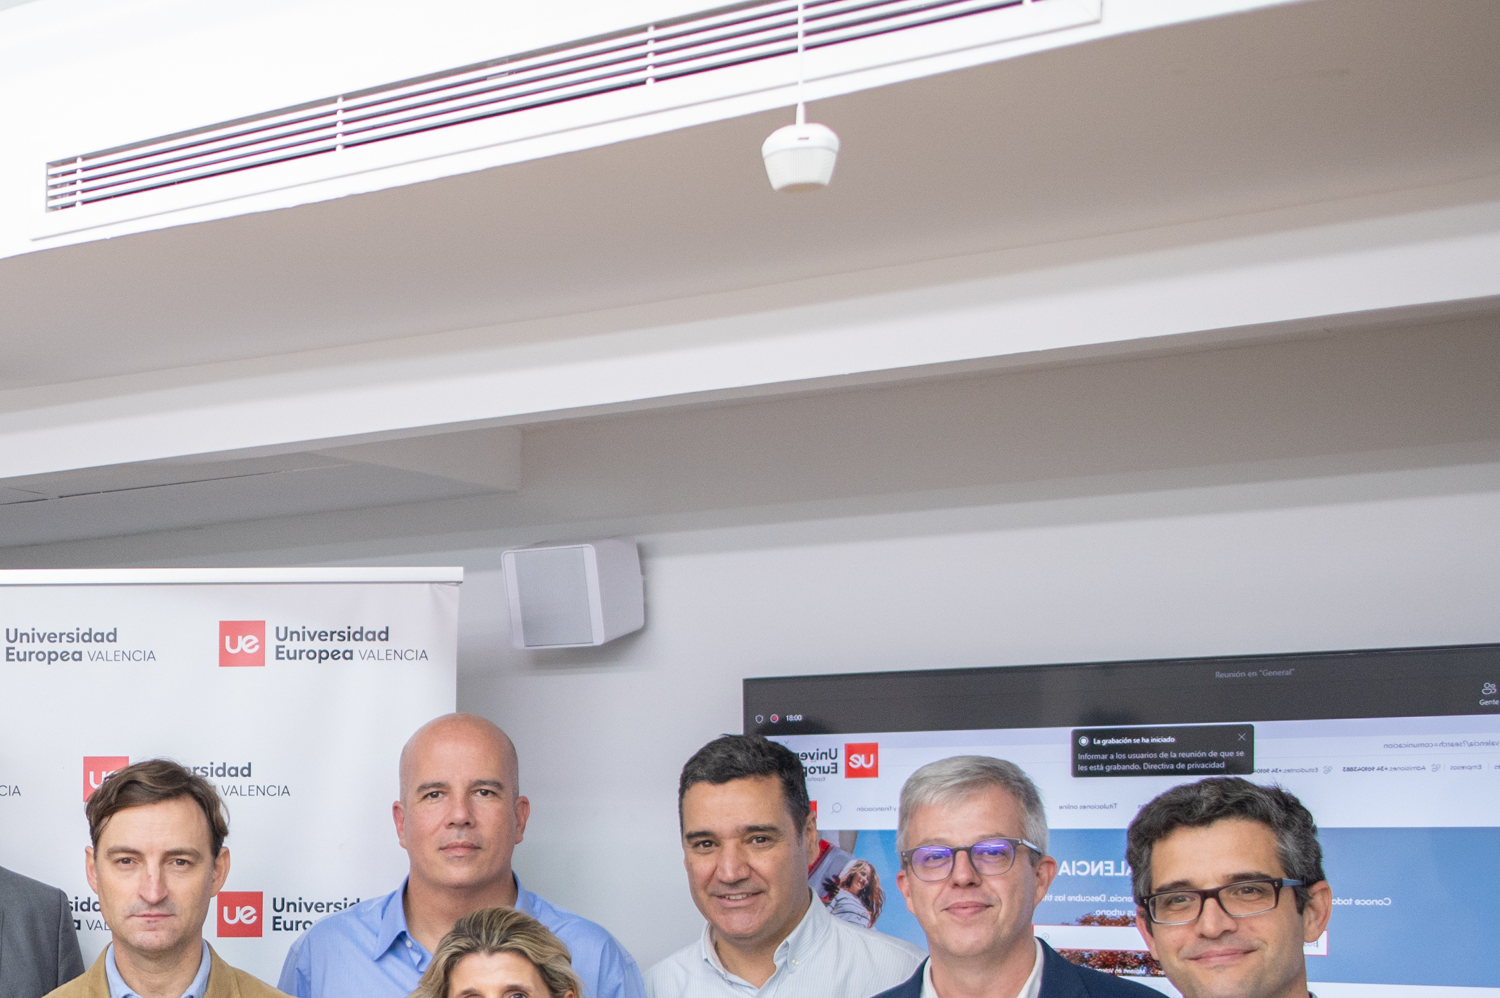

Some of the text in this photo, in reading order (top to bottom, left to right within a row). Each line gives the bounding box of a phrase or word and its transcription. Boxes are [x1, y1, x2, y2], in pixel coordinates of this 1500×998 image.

[5, 627, 118, 643] Universidad
[275, 625, 390, 642] Universidad
[224, 634, 260, 654] ue
[5, 646, 157, 665] Europea VALENCIA
[275, 645, 429, 664] Europea VALENCIA
[1215, 670, 1246, 678] Reunión
[1101, 737, 1132, 746] grabación
[1219, 751, 1234, 759] que
[1089, 763, 1103, 771] está
[1105, 763, 1141, 772] grabando.
[1143, 762, 1174, 770] Directiva
[1187, 762, 1225, 771] privacidad
[221, 784, 291, 797] VALENCIA
[223, 905, 258, 925] ue
